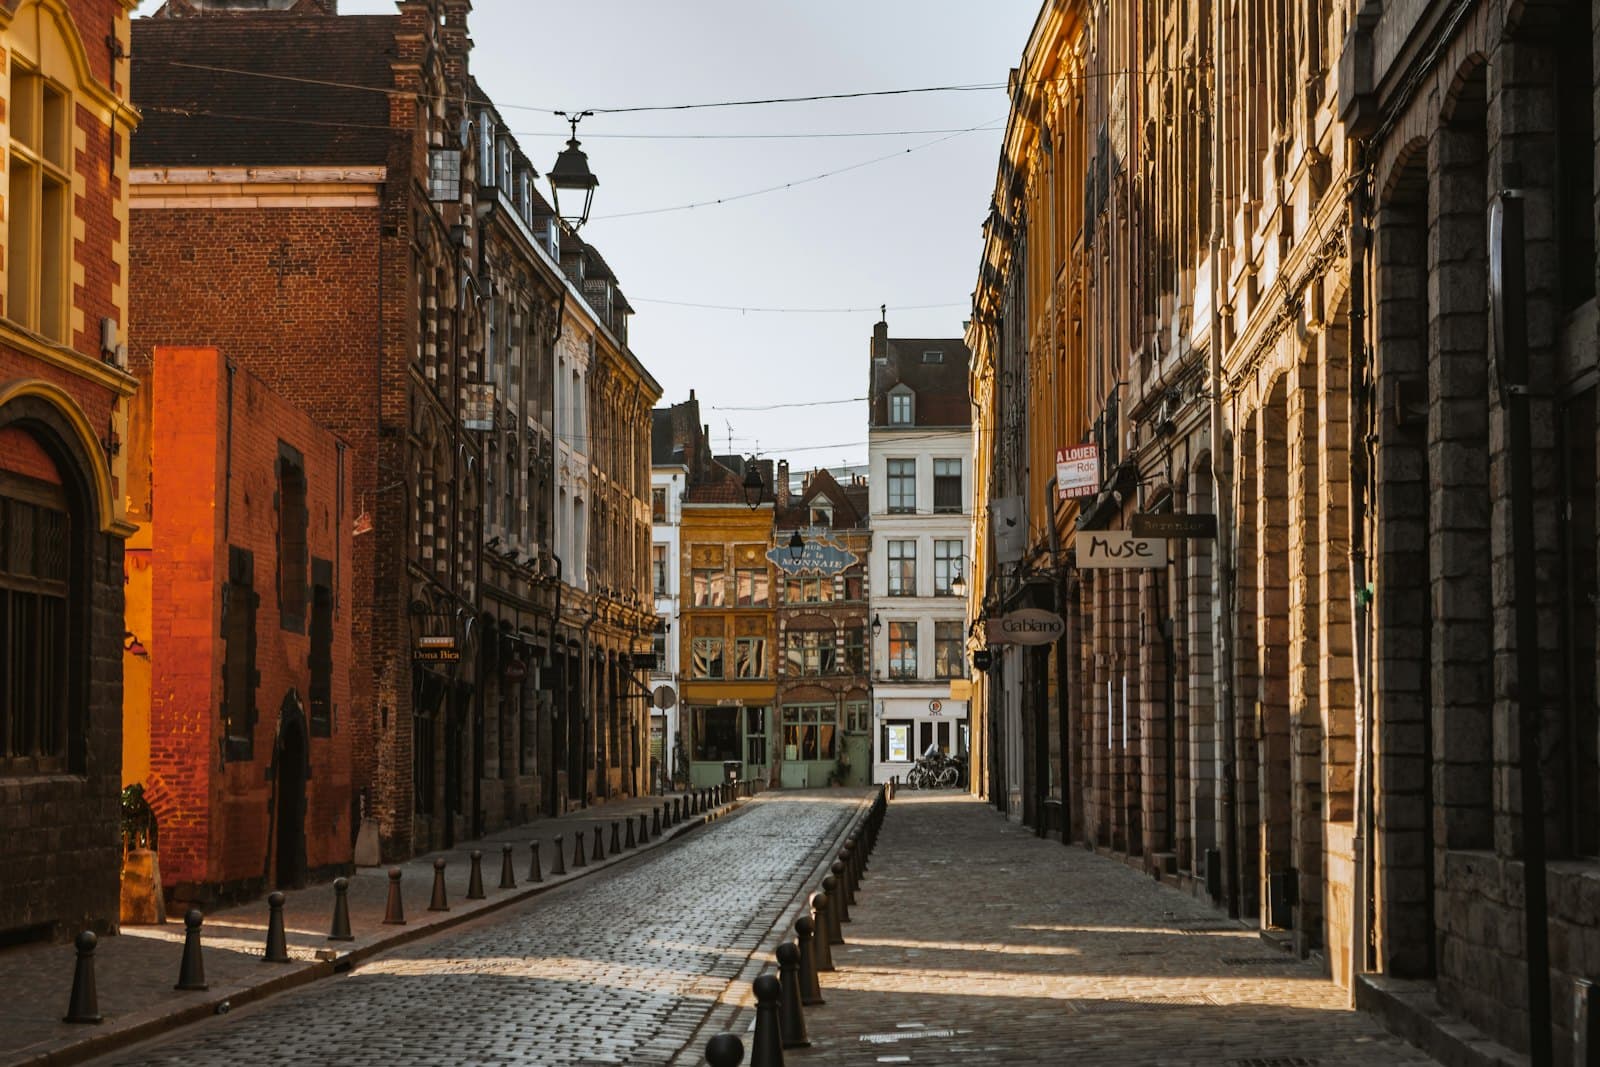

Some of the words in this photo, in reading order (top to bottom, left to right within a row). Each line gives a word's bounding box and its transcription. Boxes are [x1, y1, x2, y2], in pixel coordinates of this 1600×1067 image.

[1056, 450, 1065, 463] A
[1065, 446, 1096, 461] LOUER
[1077, 462, 1094, 473] Rdc
[1090, 536, 1153, 558] Muse
[783, 559, 842, 568] MONNAIE
[1002, 619, 1062, 633] Gabiano
[413, 650, 438, 660] Dona
[440, 650, 460, 660] Bica
